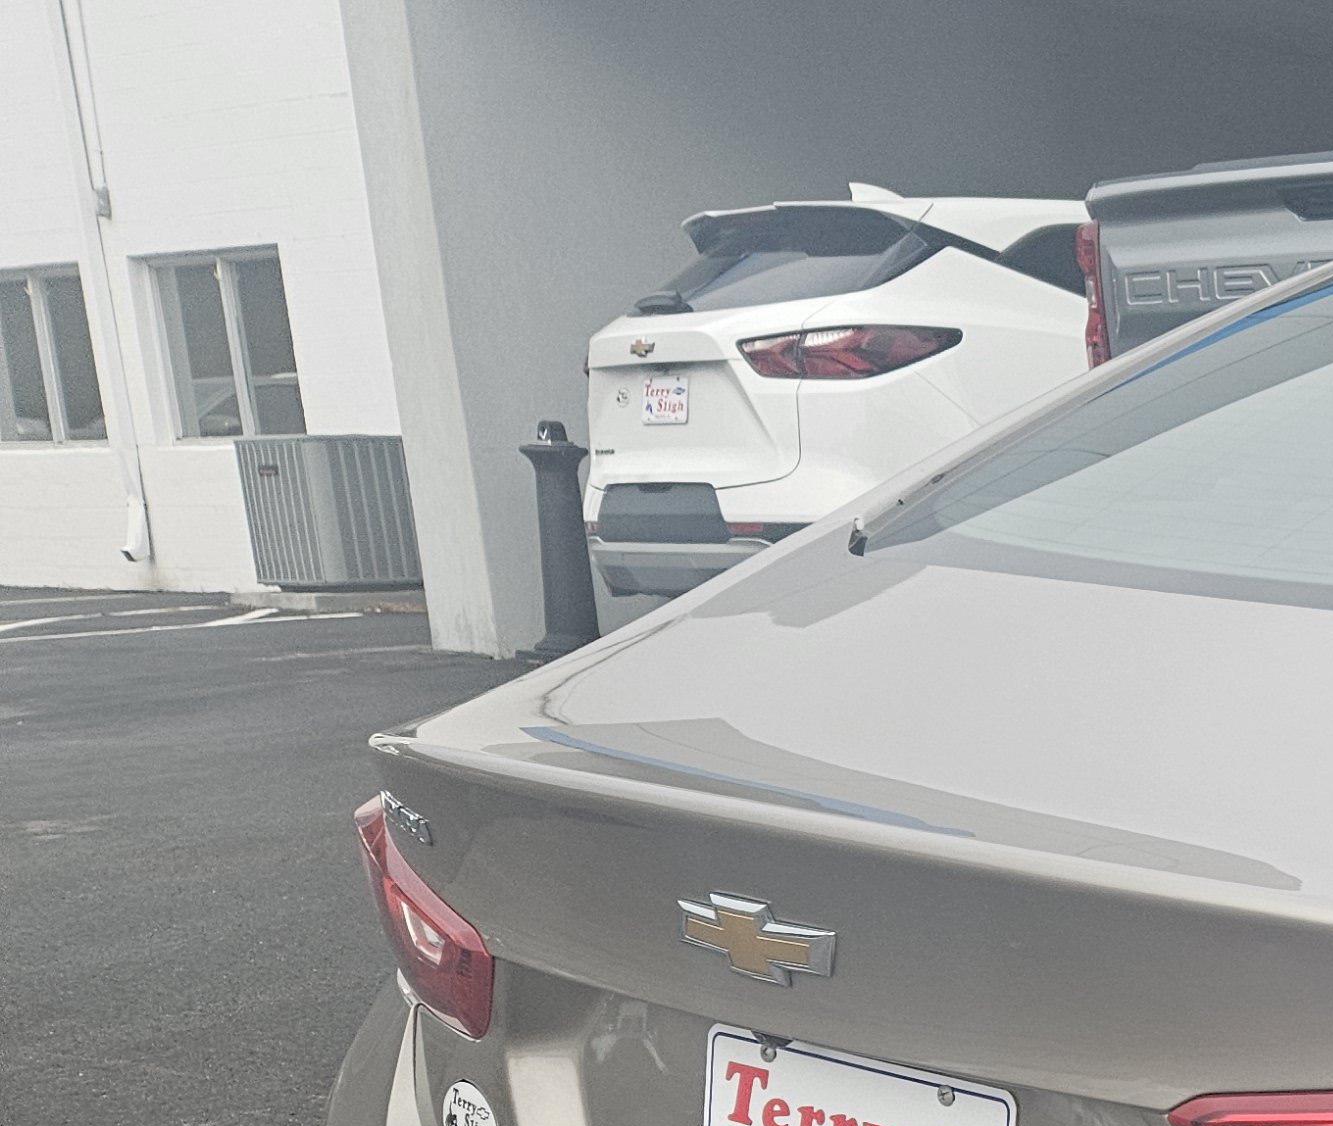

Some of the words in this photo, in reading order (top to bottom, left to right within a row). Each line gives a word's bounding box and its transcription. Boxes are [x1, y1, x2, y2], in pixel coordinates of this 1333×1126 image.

[645, 384, 671, 399] Terry
[657, 398, 684, 413] Sligh
[452, 1087, 477, 1116] Terry
